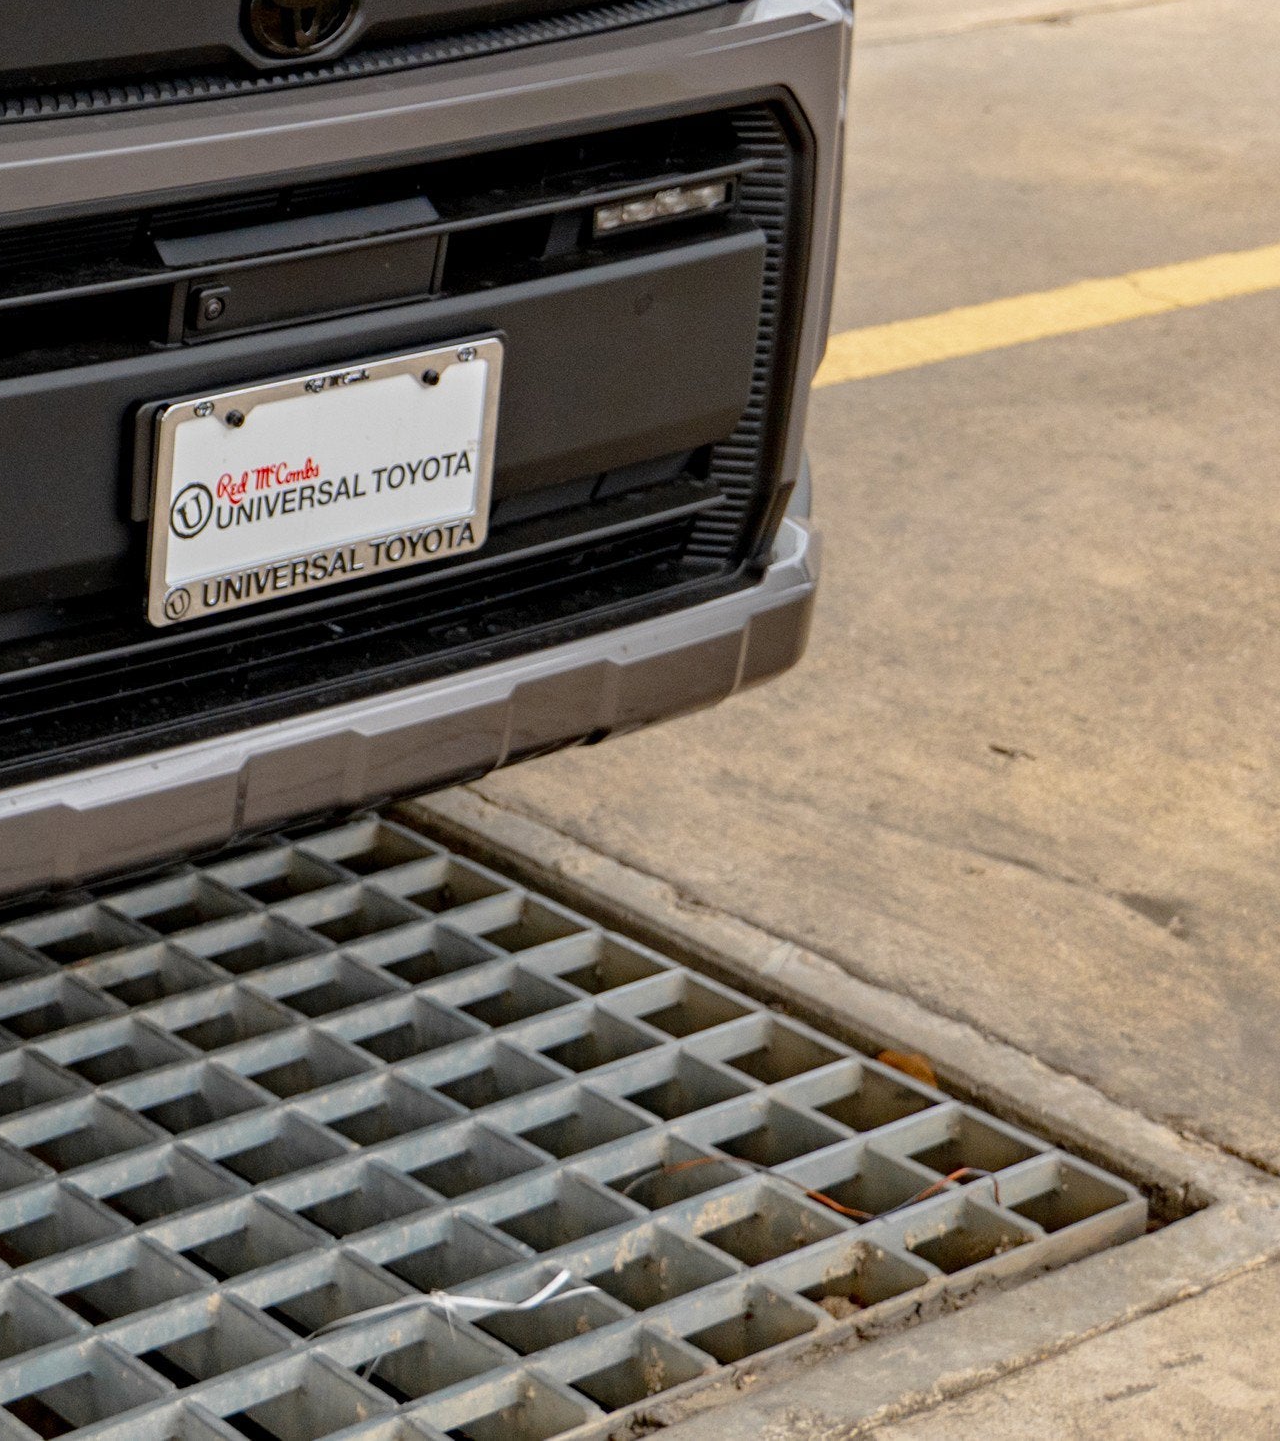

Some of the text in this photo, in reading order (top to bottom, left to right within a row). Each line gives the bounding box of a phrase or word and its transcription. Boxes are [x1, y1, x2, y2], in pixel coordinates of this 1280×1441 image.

[215, 449, 472, 530] UNIVERSAL TOYOTA
[216, 456, 320, 505] Red McCombs
[202, 543, 365, 608] UNIVERSAL
[369, 518, 475, 566] TOYOTA
